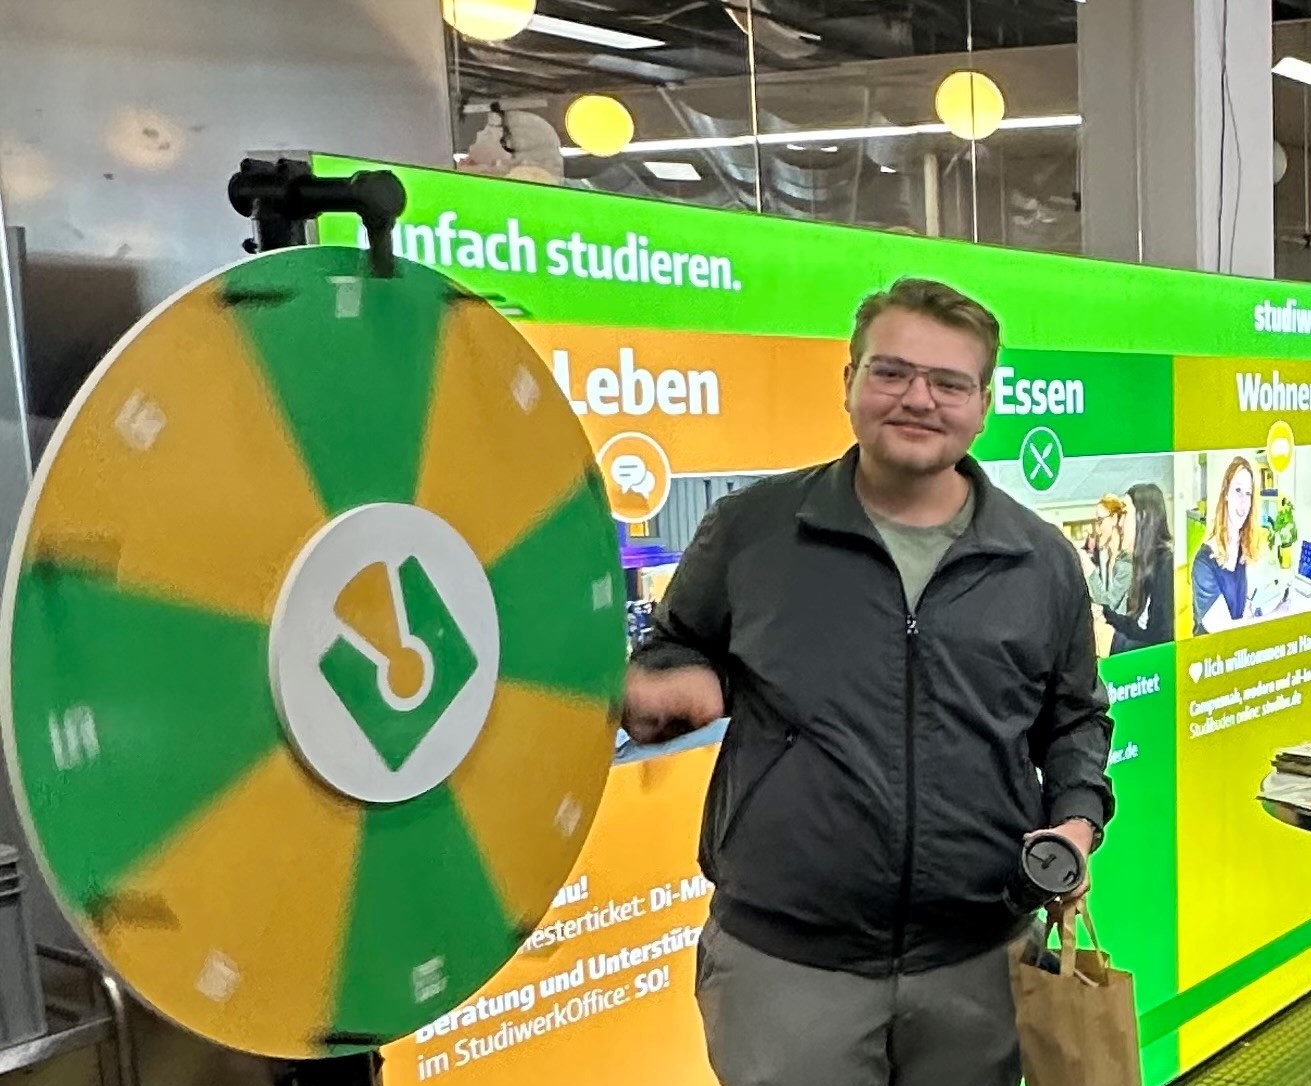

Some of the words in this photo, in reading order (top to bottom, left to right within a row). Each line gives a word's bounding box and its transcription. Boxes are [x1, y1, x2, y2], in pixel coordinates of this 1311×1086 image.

[546, 227, 742, 291] studieren.
[552, 347, 720, 416] Leben
[993, 366, 1085, 415] Essen
[1204, 655, 1224, 678] lich
[1225, 648, 1286, 672] willkommen
[1286, 641, 1298, 656] zu
[1275, 671, 1291, 691] und
[415, 982, 536, 1044] Beratung
[539, 959, 585, 999] und
[416, 1050, 449, 1082] im
[454, 984, 632, 1067] StudiwerkOffice:
